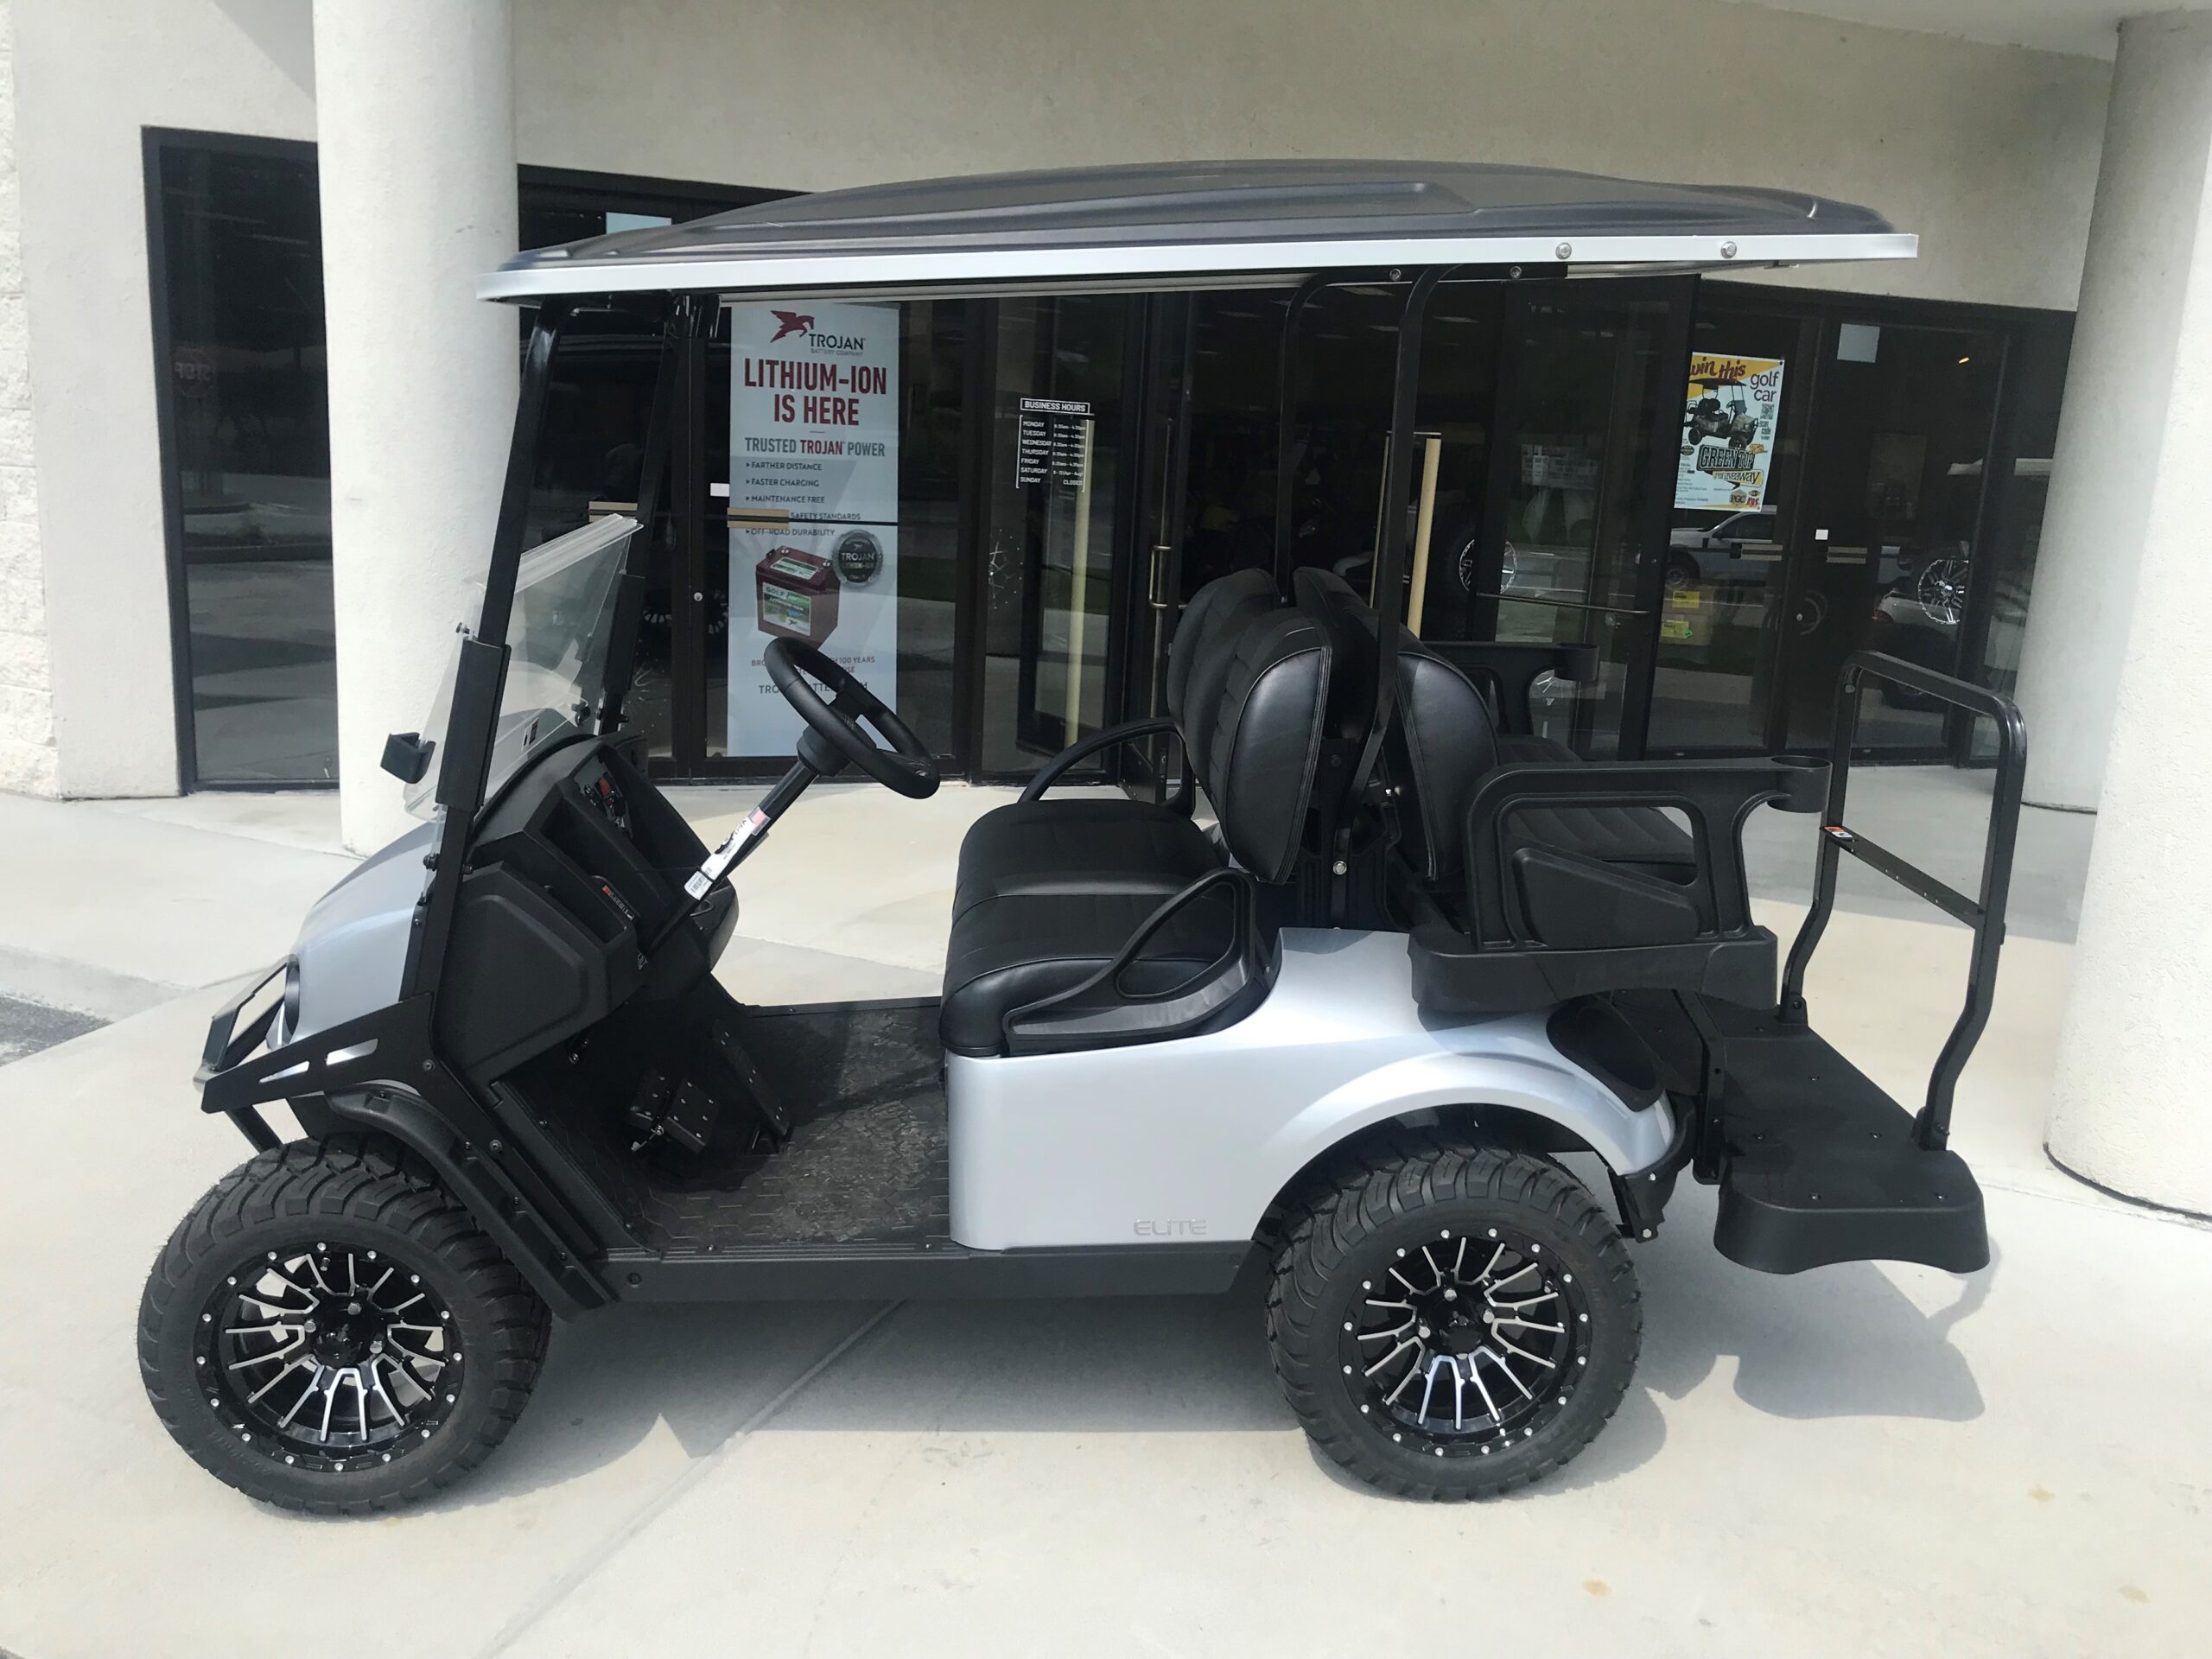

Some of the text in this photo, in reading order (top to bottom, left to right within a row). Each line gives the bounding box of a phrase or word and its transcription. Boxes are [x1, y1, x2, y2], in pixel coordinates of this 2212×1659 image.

[809, 334, 863, 350] TROJAN
[745, 358, 887, 395] LITHIUM-ION
[1719, 359, 1746, 381] this
[1750, 371, 1780, 389] golf
[1754, 389, 1777, 402] car
[774, 394, 859, 426] IS HERE
[1025, 401, 1086, 412] BUSINESS HOURS
[745, 437, 885, 456] TRUSTED TROJAN POWER
[1700, 446, 1735, 469] GREEN
[1738, 449, 1754, 469] TOP
[842, 552, 874, 561] TROJAN
